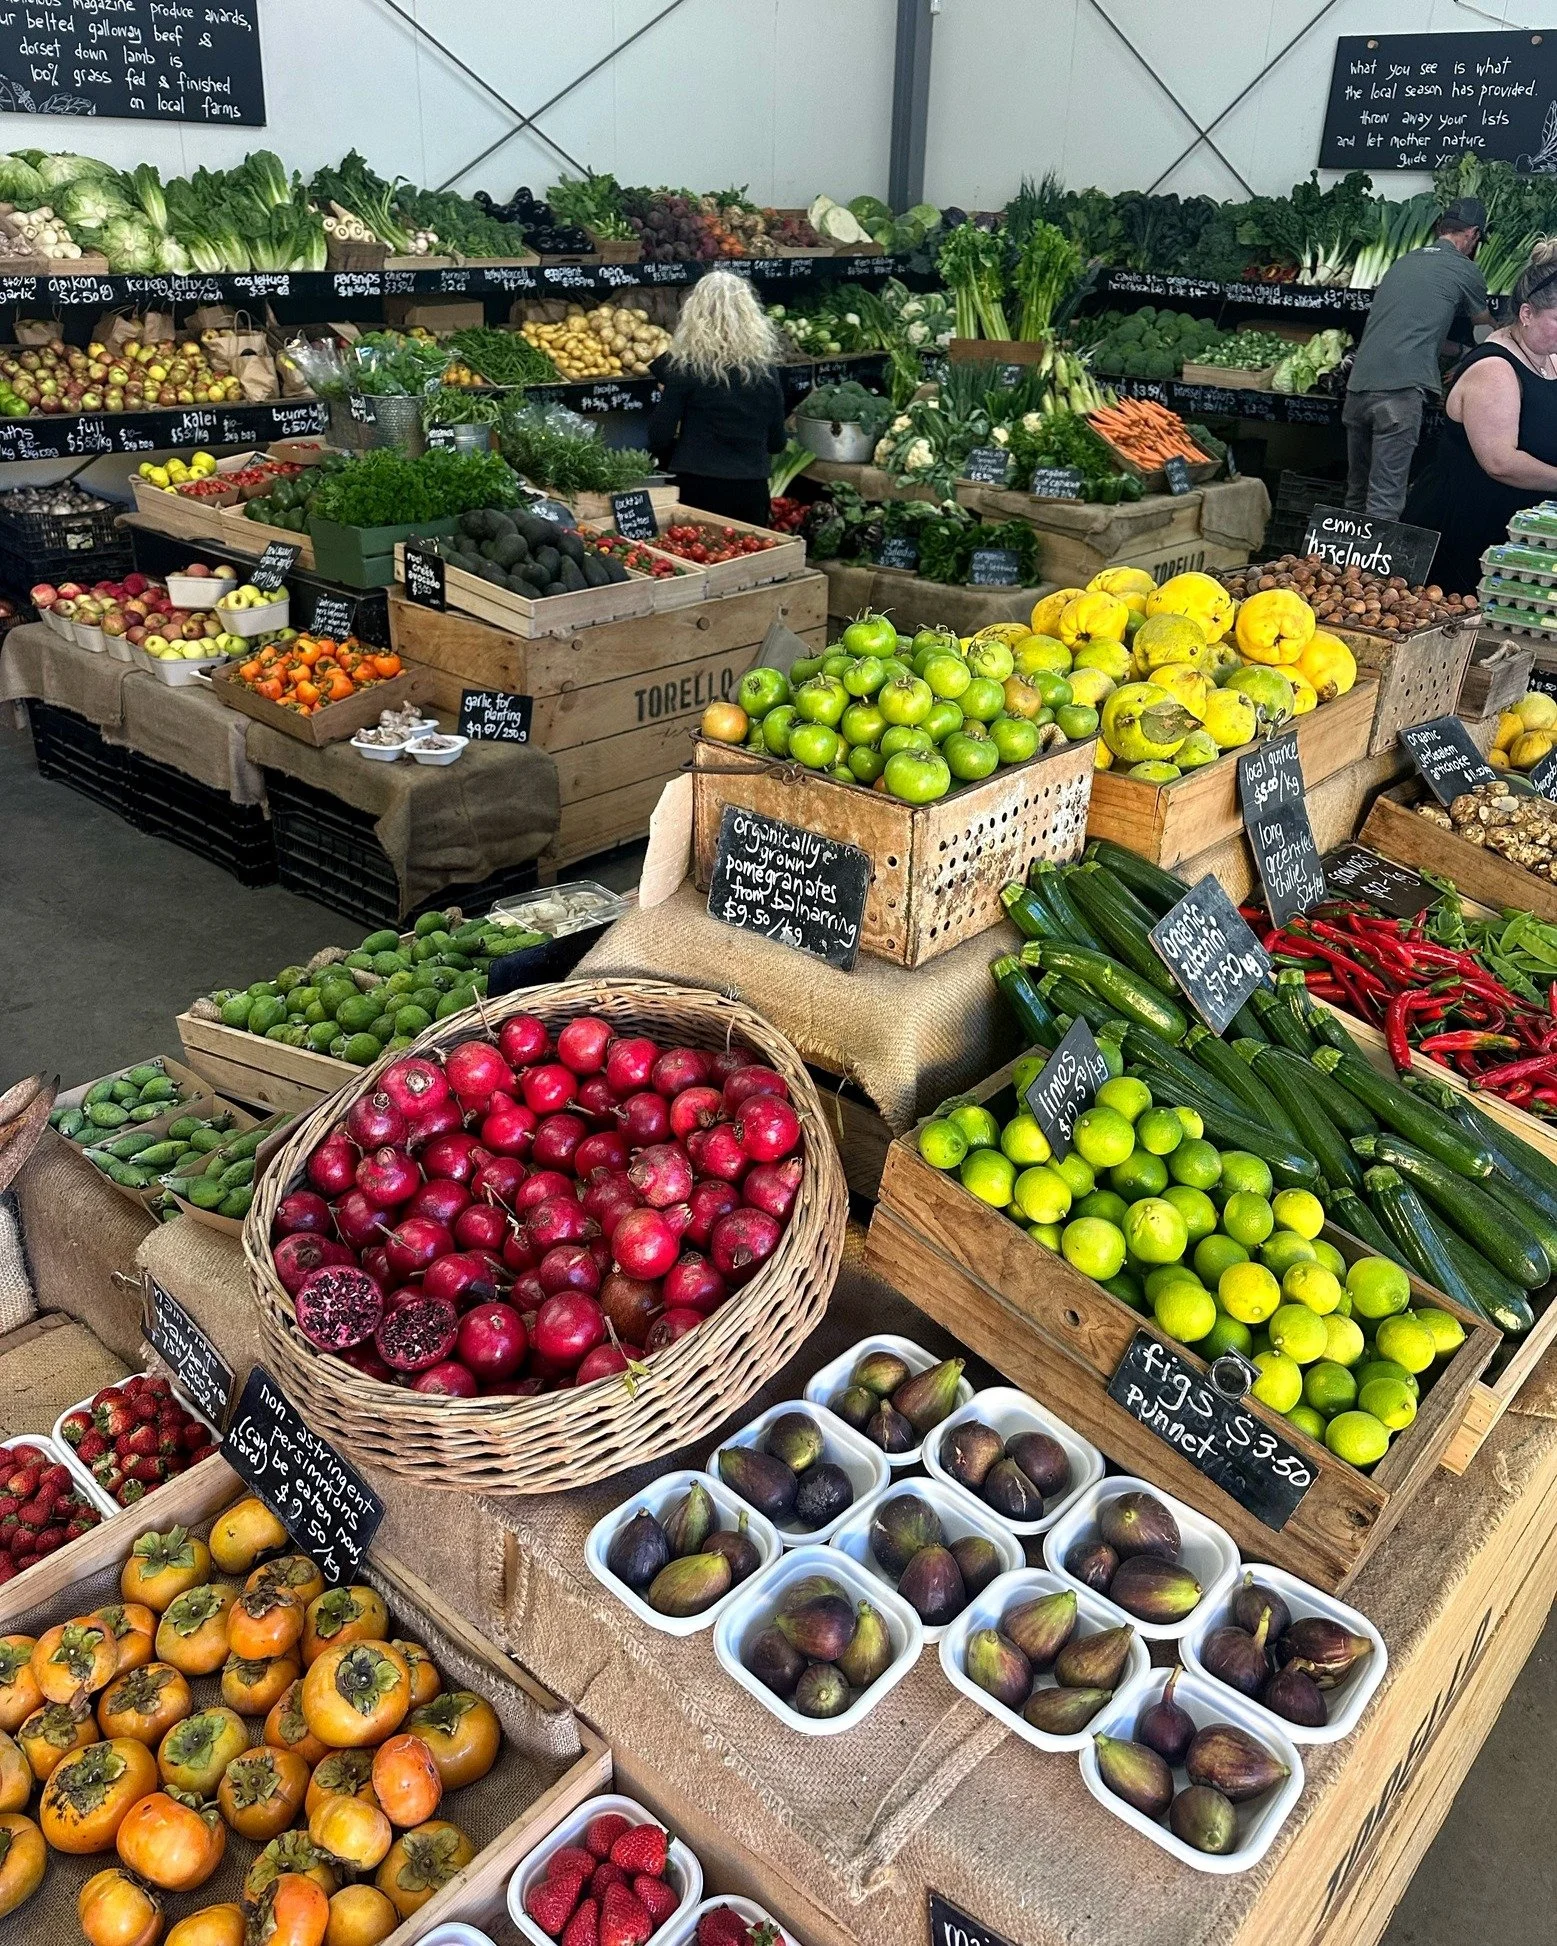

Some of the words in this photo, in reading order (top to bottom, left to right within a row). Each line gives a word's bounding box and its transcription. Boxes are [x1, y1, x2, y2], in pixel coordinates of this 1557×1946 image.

[150, 2, 194, 21] produce
[26, 9, 74, 33] belted
[88, 19, 142, 44] galloway
[153, 24, 183, 46] beef
[198, 32, 213, 47] &
[19, 36, 61, 58] dorset
[74, 43, 108, 61] down
[123, 45, 156, 65] lamb
[169, 53, 183, 68] is
[30, 62, 59, 86] 100%
[73, 70, 112, 87] grass
[124, 69, 146, 91] fed
[158, 77, 170, 89] &
[176, 72, 232, 94] finished
[1350, 59, 1377, 76] what
[1385, 63, 1411, 81] you
[1419, 62, 1438, 76] see
[1454, 60, 1466, 75] is
[1476, 56, 1512, 76] what
[129, 98, 145, 110] on
[157, 93, 186, 114] local
[201, 98, 242, 118] farms
[1344, 85, 1363, 101] the
[1370, 82, 1398, 100] local
[1404, 85, 1443, 97] season
[1451, 81, 1474, 98] has
[1478, 79, 1538, 106] provided.
[1359, 110, 1390, 126] throw
[1401, 112, 1433, 131] away
[1437, 113, 1468, 131] your
[1481, 110, 1510, 126] lists
[1336, 135, 1356, 147] and
[1366, 133, 1384, 147] let
[1390, 134, 1431, 149] mother
[1442, 130, 1486, 147] nature
[1397, 152, 1427, 168] guide
[254, 275, 289, 286] lettuce
[334, 272, 380, 290] parsnips
[0, 288, 35, 304] garlic
[76, 416, 105, 438] fuji
[1322, 517, 1373, 539] ennis
[1307, 528, 1393, 575] hazelnuts
[464, 695, 492, 711] garlic
[495, 696, 513, 710] for
[634, 668, 734, 722] TORELLO
[484, 708, 521, 726] planting
[1407, 728, 1441, 754] organic
[1244, 755, 1267, 785] local
[1268, 741, 1299, 772] quince
[1416, 744, 1458, 768] jerusalem
[1430, 754, 1471, 780] artichoke
[734, 816, 820, 869] organically
[1258, 822, 1285, 850] long
[755, 846, 806, 875] grown
[726, 854, 837, 904] pomegranates
[1275, 859, 1308, 897] chillies
[730, 876, 765, 905] from
[771, 890, 858, 948] balnarring
[1162, 902, 1205, 959] organic
[1038, 1050, 1076, 1120] limes
[187, 1324, 218, 1372] ridge
[1143, 1343, 1214, 1418] figs
[229, 1428, 268, 1475] hard)
[238, 1416, 268, 1455] (can
[273, 1450, 289, 1476] be
[296, 1479, 331, 1526] eaten
[270, 1425, 358, 1530] persimmons
